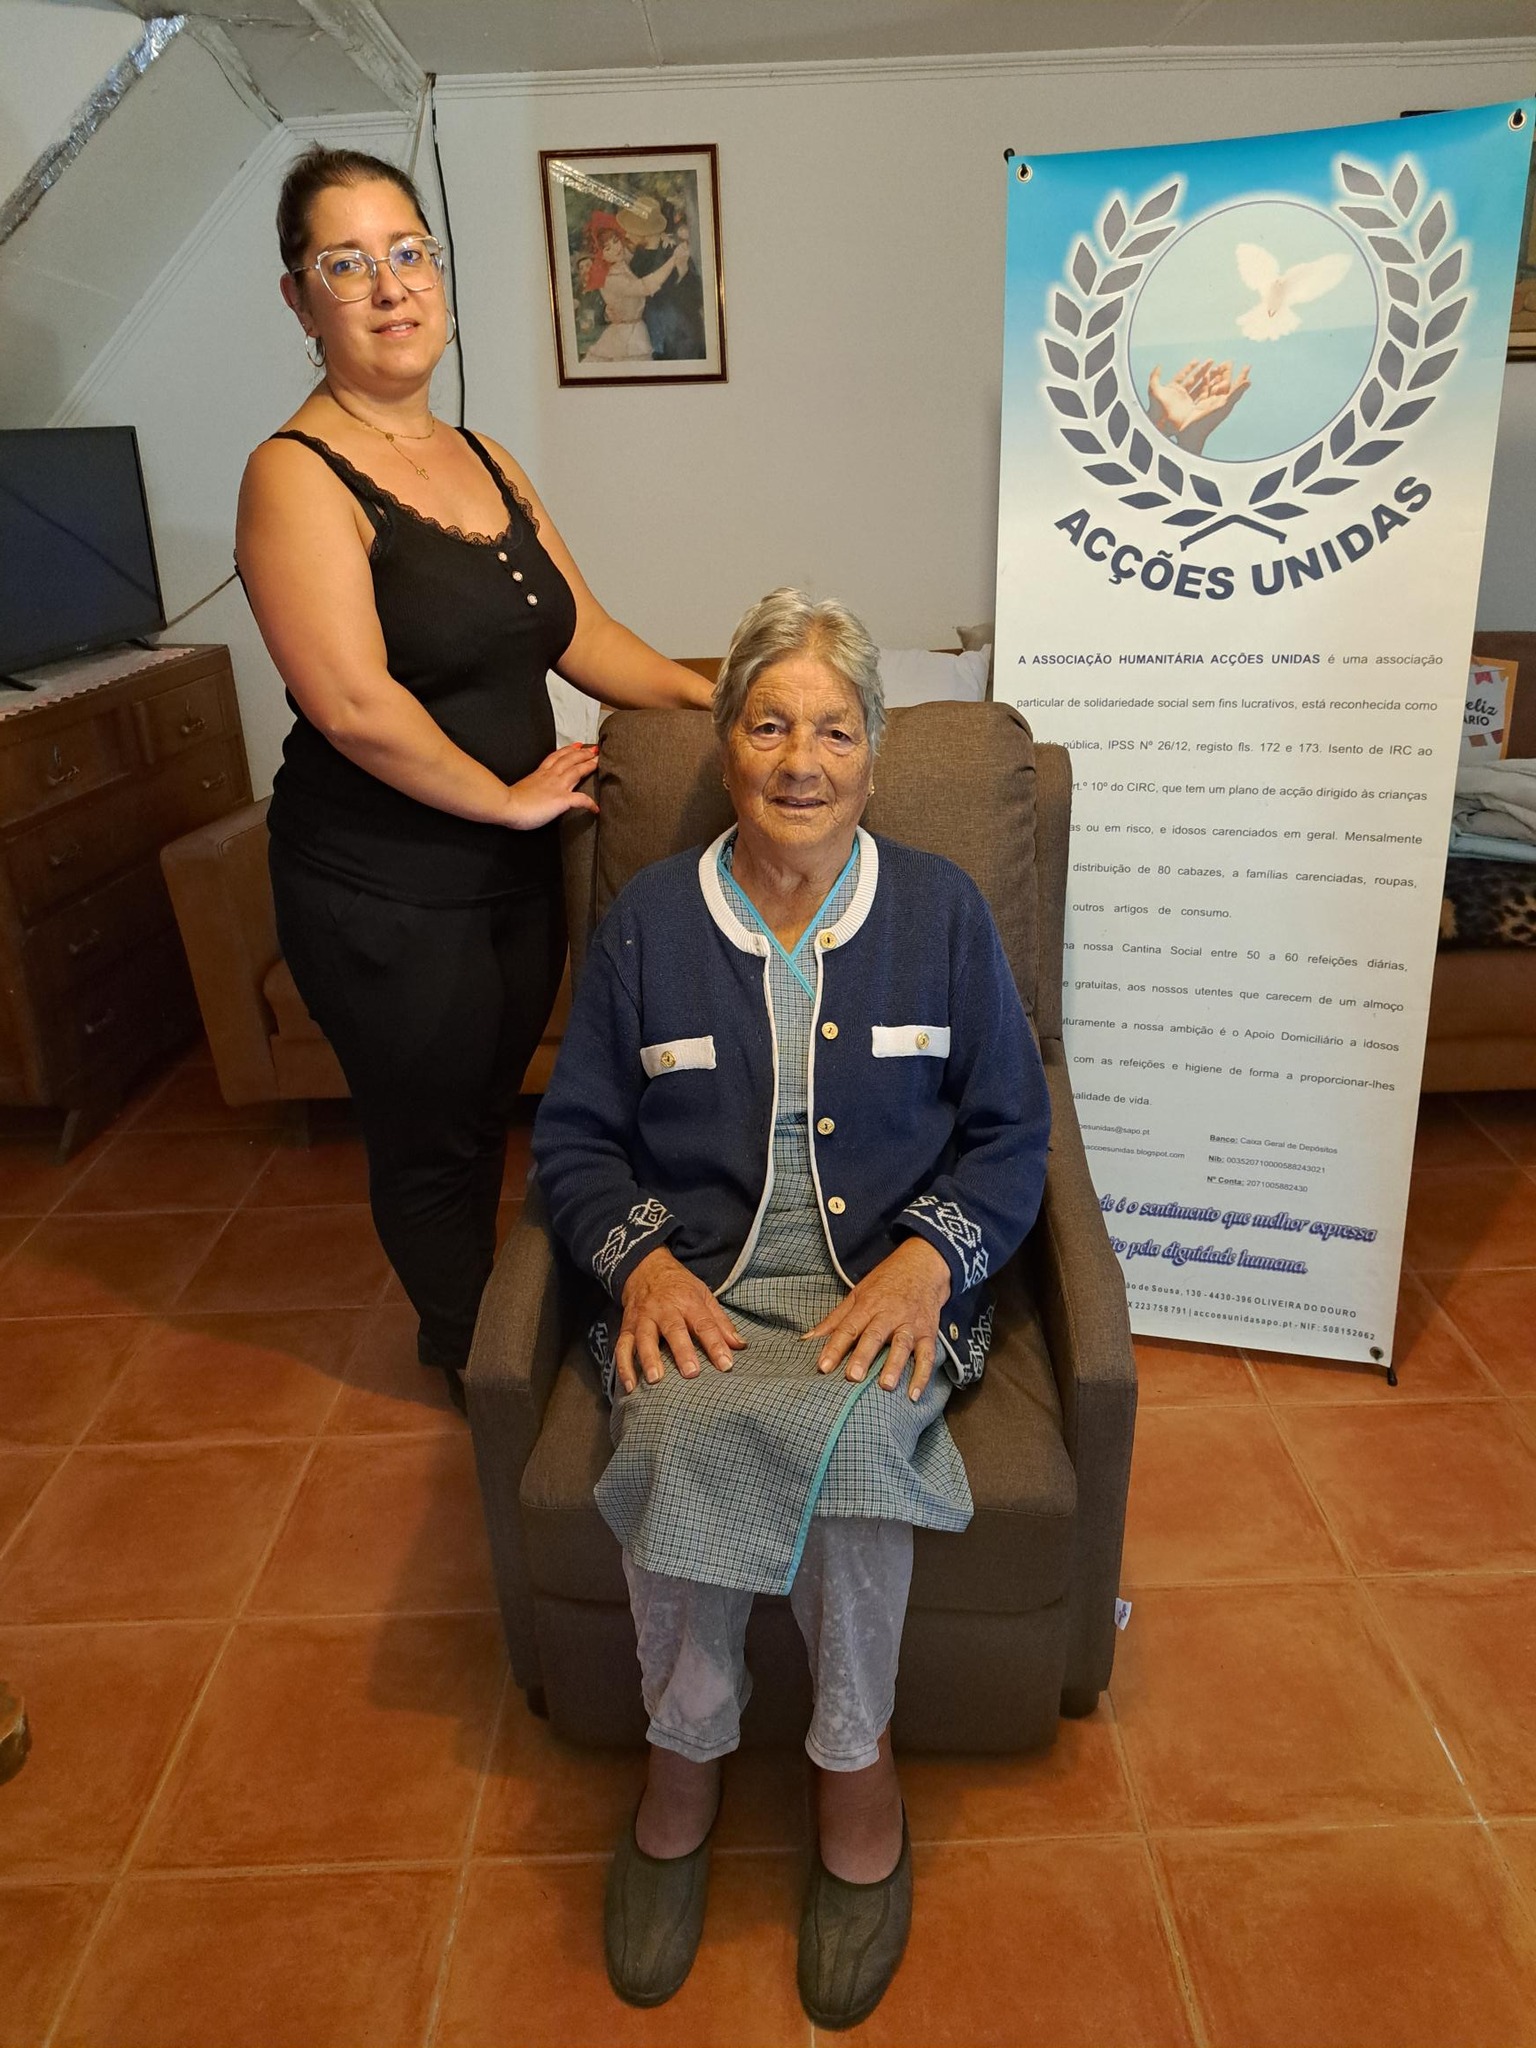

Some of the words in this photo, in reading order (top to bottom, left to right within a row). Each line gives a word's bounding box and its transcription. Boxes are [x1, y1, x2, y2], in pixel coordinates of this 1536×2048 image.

[1054, 507, 1235, 600] ACÇÕES
[1251, 476, 1432, 596] UNIDAS
[1017, 654, 1027, 665] A
[1031, 652, 1113, 667] ASSOCIAÇÃO
[1118, 651, 1205, 665] HUMANITÁRIA
[1209, 651, 1264, 667] ACÇÕES
[1271, 653, 1321, 665] UNIDAS
[1327, 653, 1336, 665] é
[1342, 655, 1369, 665] uma
[1375, 653, 1444, 668] associação
[1016, 697, 1065, 710] particular
[1066, 697, 1081, 708] de
[1083, 697, 1155, 708] solidariedade
[1157, 697, 1189, 709] social
[1191, 699, 1216, 709] sem
[1218, 697, 1238, 709] fins
[1241, 698, 1298, 711] lucrativos,
[1301, 698, 1326, 710] está
[1329, 699, 1402, 711] reconhecida
[1404, 702, 1438, 712] como
[1465, 698, 1498, 716] eliz
[1107, 739, 1135, 751] IPSS
[1139, 739, 1154, 751] Nº
[1157, 740, 1191, 752] 26/12,
[1195, 741, 1234, 754] registo
[1237, 741, 1254, 753] fls.
[1260, 742, 1281, 753] 172
[1285, 744, 1293, 753] e
[1298, 742, 1323, 754] 173.
[1328, 743, 1364, 755] Isento
[1368, 744, 1384, 755] de
[1389, 744, 1413, 756] IRC
[1416, 747, 1433, 757] ao
[1110, 782, 1125, 792] do
[1126, 781, 1159, 794] CIRC,
[1161, 785, 1183, 795] que
[1185, 784, 1206, 794] tem
[1208, 786, 1226, 795] um
[1228, 784, 1260, 797] plano
[1261, 785, 1277, 796] de
[1278, 786, 1314, 799] acção
[1315, 787, 1358, 800] dirigido
[1360, 788, 1375, 800] às
[1377, 789, 1428, 803] crianças
[1085, 824, 1100, 833] ou
[1104, 824, 1121, 833] em
[1126, 823, 1154, 835] risco,
[1159, 826, 1167, 835] e
[1171, 824, 1207, 836] idosos
[1211, 827, 1279, 838] carenciados
[1283, 830, 1302, 839] em
[1306, 830, 1338, 842] geral.
[1344, 831, 1423, 845] Mensalmente
[1072, 862, 1132, 875] distribuição
[1137, 864, 1151, 875] de
[1157, 864, 1172, 875] 80
[1177, 866, 1225, 879] cabazes,
[1231, 870, 1240, 878] a
[1246, 868, 1289, 881] famílias
[1295, 872, 1367, 886] carenciadas,
[1374, 877, 1417, 889] roupas,
[1072, 903, 1105, 913] outros
[1113, 904, 1149, 916] artigos
[1157, 905, 1172, 915] de
[1180, 908, 1232, 919] consumo.
[1083, 943, 1114, 952] nossa
[1121, 943, 1162, 955] Cantina
[1169, 945, 1203, 957] Social
[1210, 949, 1238, 959] entre
[1246, 949, 1261, 960] 50
[1268, 953, 1276, 961] a
[1284, 952, 1299, 963] 60
[1307, 954, 1359, 968] refeições
[1366, 958, 1408, 973] diárias,
[1074, 980, 1121, 992] gratuitas,
[1126, 983, 1147, 992] aos
[1151, 985, 1189, 995] nossos
[1194, 987, 1234, 998] utentes
[1238, 991, 1260, 1001] que
[1265, 992, 1313, 1004] carecem
[1318, 995, 1333, 1005] de
[1338, 998, 1357, 1007] um
[1363, 1000, 1404, 1011] almoço
[1120, 1021, 1128, 1030] a
[1133, 1022, 1165, 1032] nossa
[1169, 1024, 1214, 1037] ambição
[1219, 1026, 1227, 1037] é
[1231, 1029, 1240, 1038] o
[1243, 1028, 1275, 1040] Apoio
[1280, 1031, 1344, 1046] Domiciliário
[1349, 1039, 1357, 1047] a
[1362, 1038, 1400, 1052] idosos
[1073, 1055, 1095, 1064] com
[1100, 1057, 1113, 1066] as
[1119, 1057, 1166, 1070] refeições
[1171, 1063, 1179, 1071] e
[1184, 1062, 1223, 1075] higiene
[1228, 1066, 1243, 1076] de
[1249, 1067, 1280, 1079] forma
[1285, 1072, 1294, 1080] a
[1299, 1074, 1396, 1092] proporcionar-lhes
[1113, 1094, 1126, 1104] de
[1128, 1095, 1153, 1106] vida.
[1209, 1133, 1239, 1145] Banco:
[1239, 1136, 1263, 1146] Caixa
[1263, 1139, 1286, 1148] Geral
[1286, 1142, 1298, 1150] de
[1206, 1175, 1217, 1184] Nº
[1218, 1177, 1244, 1186] Conta:
[1245, 1179, 1309, 1193] 2071005882430
[1115, 1197, 1126, 1213] é
[1126, 1202, 1139, 1214] o
[1139, 1202, 1220, 1221] sentimento
[1222, 1211, 1251, 1229] que
[1252, 1212, 1310, 1232] melhor
[1309, 1220, 1378, 1242] expressa
[1126, 1239, 1161, 1259] pela
[1162, 1241, 1237, 1266] dignidade
[1237, 1249, 1309, 1275] humana.
[1138, 1283, 1150, 1292] de
[1185, 1288, 1202, 1298] 130
[1253, 1296, 1302, 1311] OLIVEIRA
[1303, 1302, 1319, 1313] DO
[1319, 1305, 1357, 1319] DOURO
[1134, 1301, 1151, 1311] 223
[1151, 1303, 1169, 1314] 758
[1170, 1305, 1187, 1316] 791
[1321, 1324, 1376, 1342] 508152062
